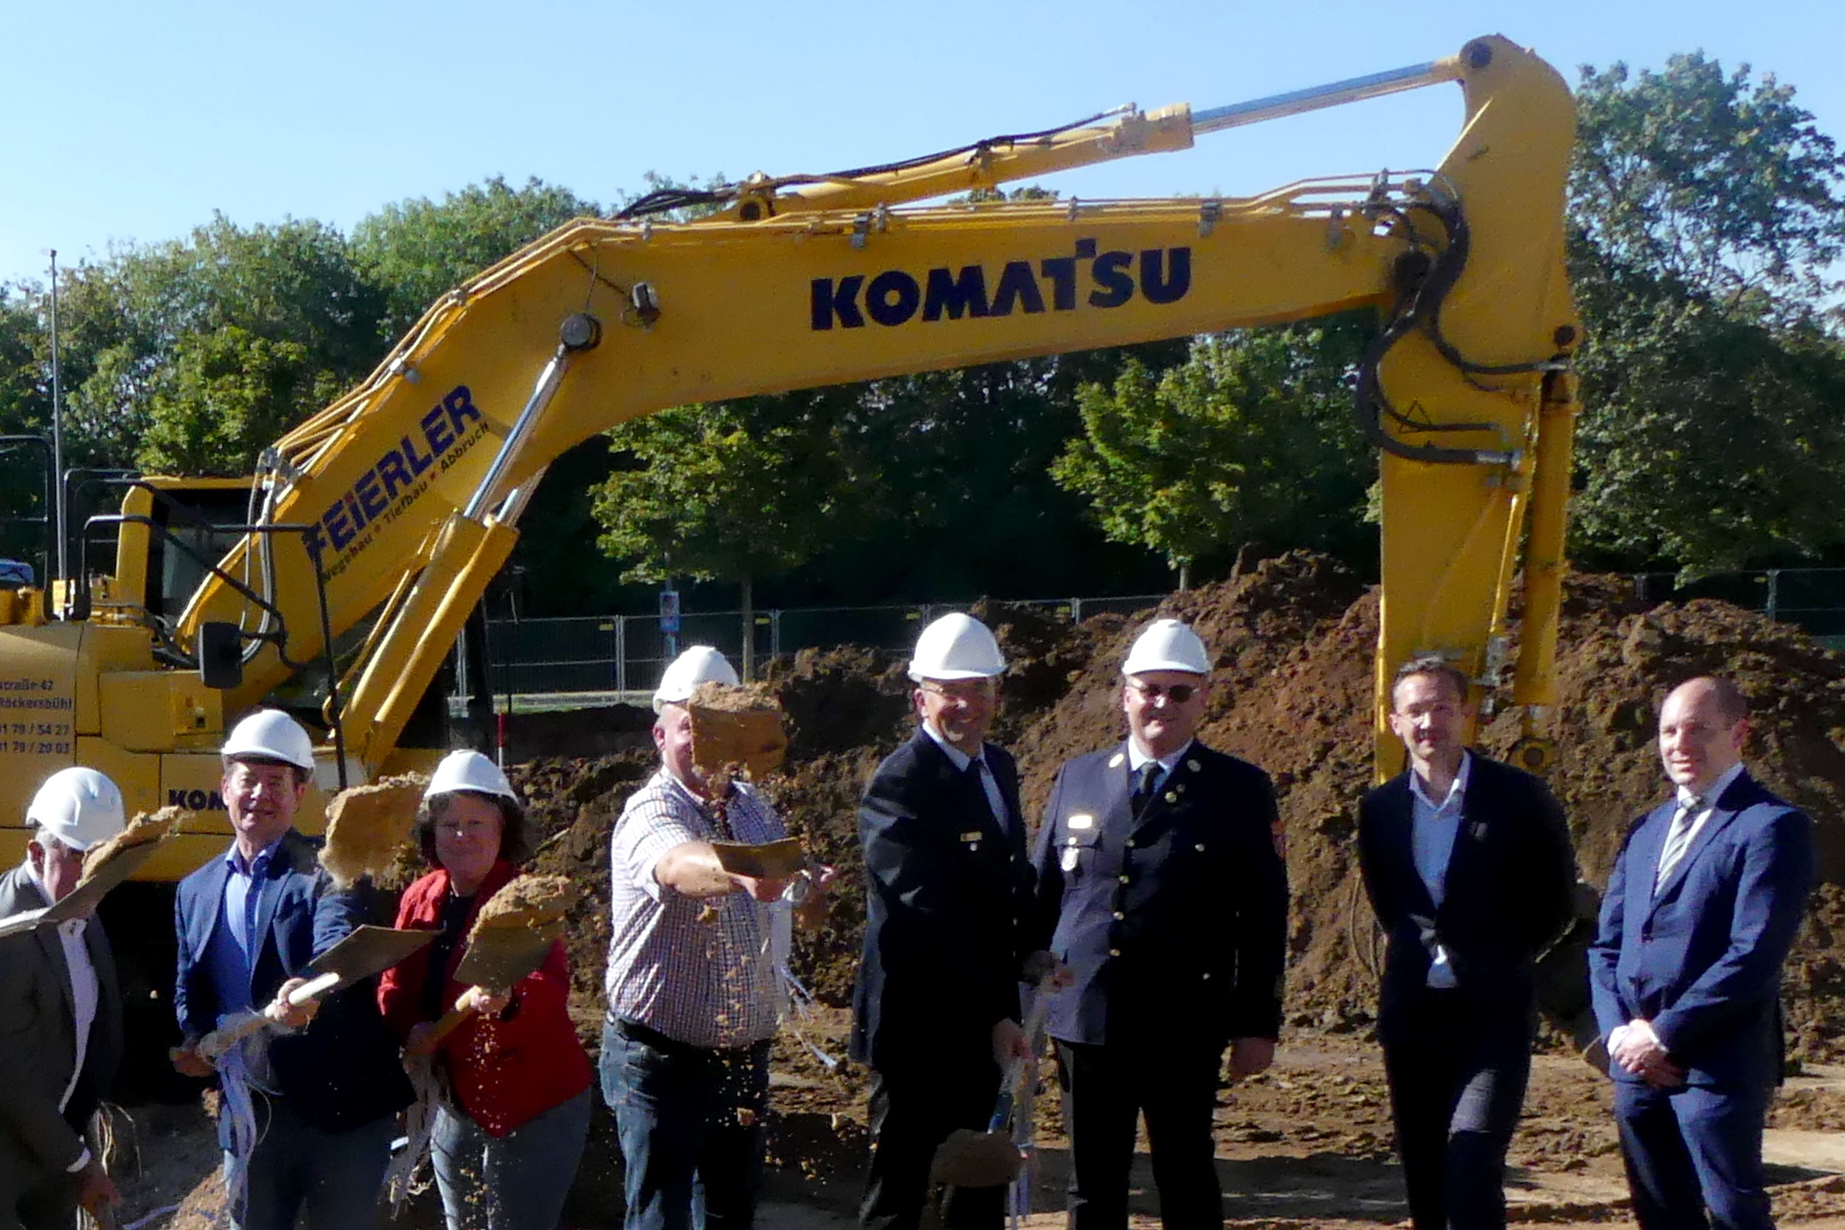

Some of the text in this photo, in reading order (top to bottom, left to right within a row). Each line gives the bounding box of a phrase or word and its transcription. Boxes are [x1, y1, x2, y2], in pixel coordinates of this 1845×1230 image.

[811, 237, 1192, 330] KOMATSU
[383, 480, 429, 524] Tiefbau
[440, 420, 490, 474] Abbruch
[169, 789, 229, 811] KOM
